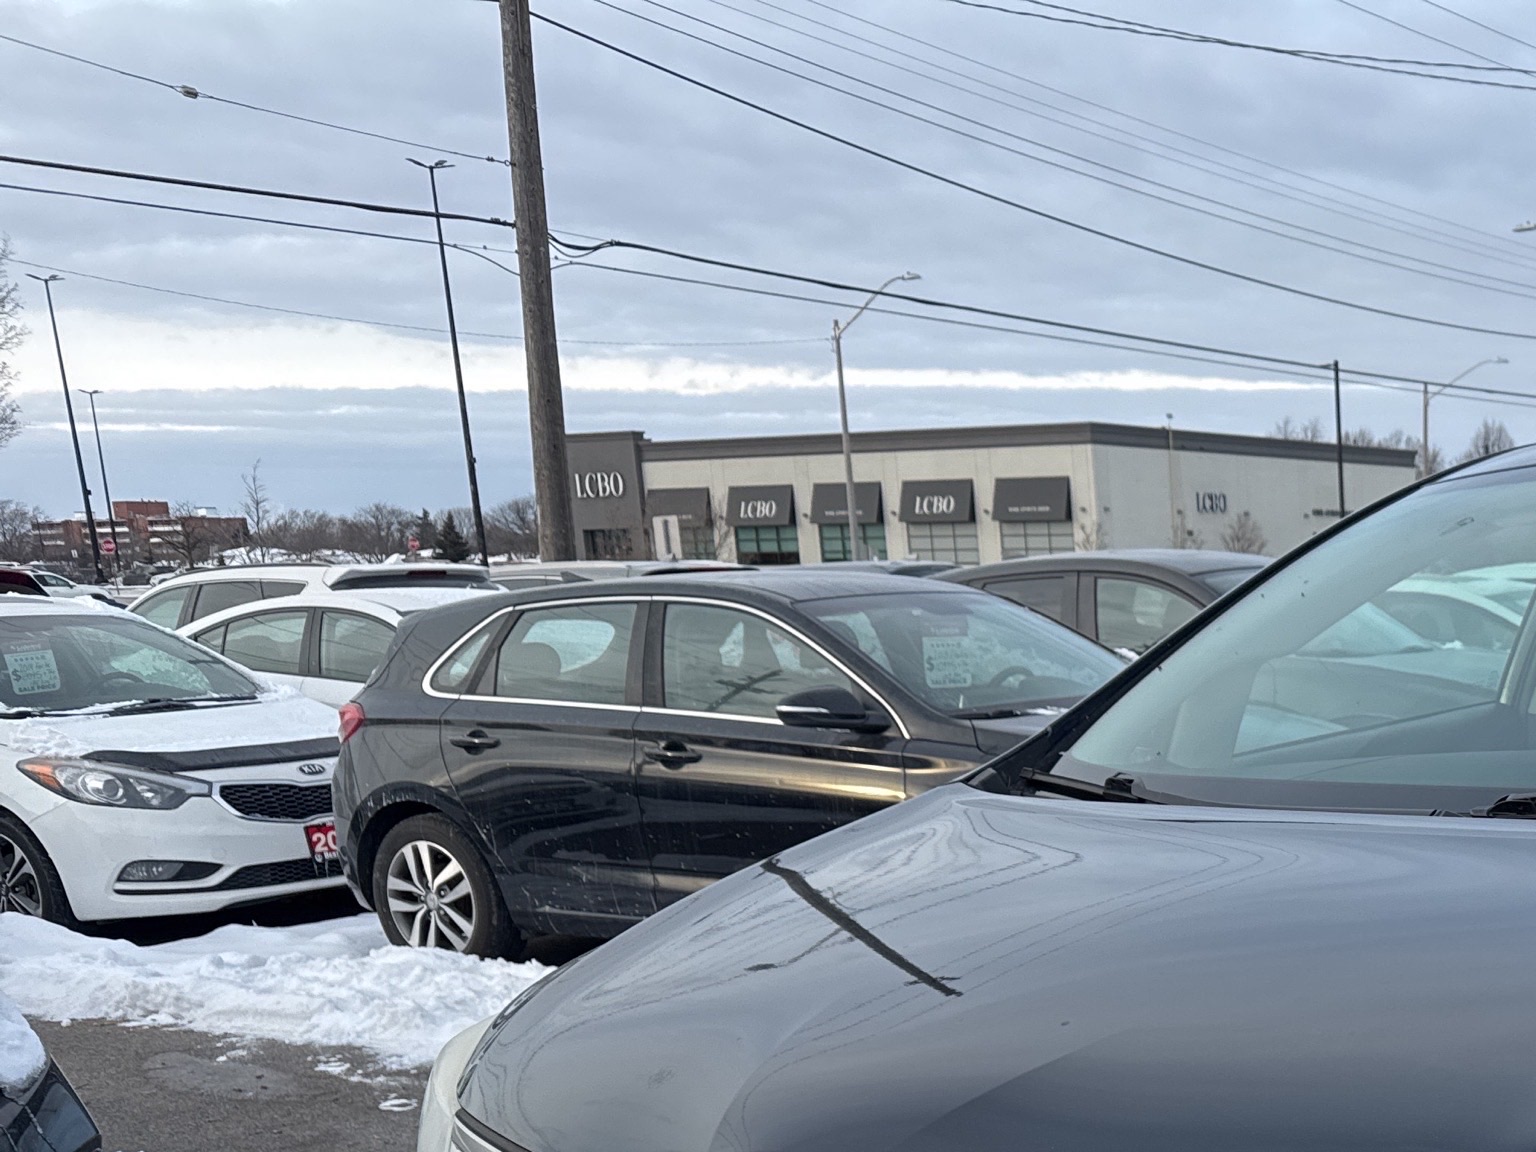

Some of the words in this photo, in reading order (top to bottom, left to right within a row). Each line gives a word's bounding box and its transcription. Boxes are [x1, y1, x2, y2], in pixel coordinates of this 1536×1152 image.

[574, 471, 624, 499] LCBO
[739, 500, 777, 519] LCBO
[914, 495, 955, 515] LCBO
[1196, 492, 1228, 514] LCBO
[302, 764, 323, 774] KIA
